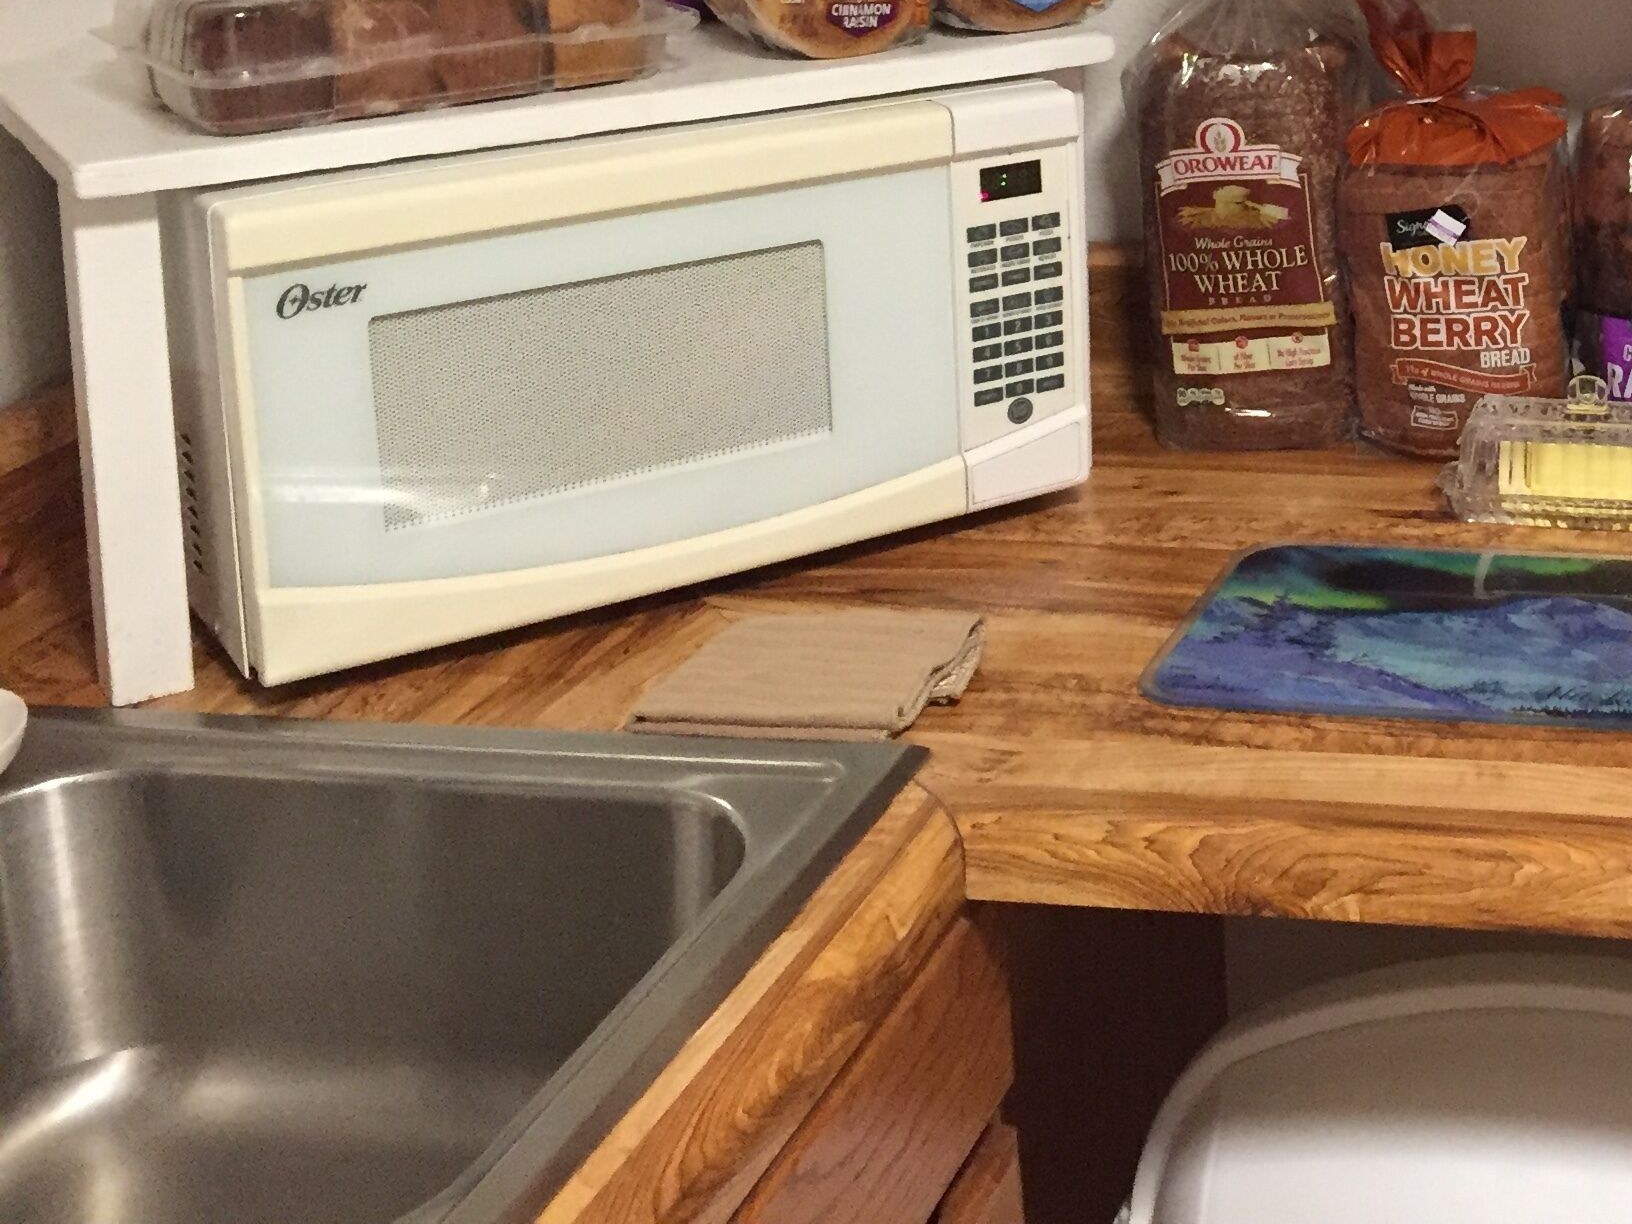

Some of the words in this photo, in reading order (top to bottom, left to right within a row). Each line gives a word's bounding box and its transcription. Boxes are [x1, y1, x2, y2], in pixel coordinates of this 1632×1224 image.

[832, 3, 891, 16] CINNAMON
[1173, 155, 1277, 175] OROWEAT
[1195, 237, 1230, 249] Whole
[1233, 235, 1273, 248] Grains
[1169, 252, 1219, 272] 100%
[1221, 244, 1308, 271] WHOLE
[1380, 236, 1527, 277] HONEY
[1194, 270, 1282, 295] WHEAT
[1384, 273, 1529, 314] WHEAT
[276, 283, 367, 320] Oster
[1390, 309, 1531, 351] BERRY
[1480, 348, 1531, 369] BREAD
